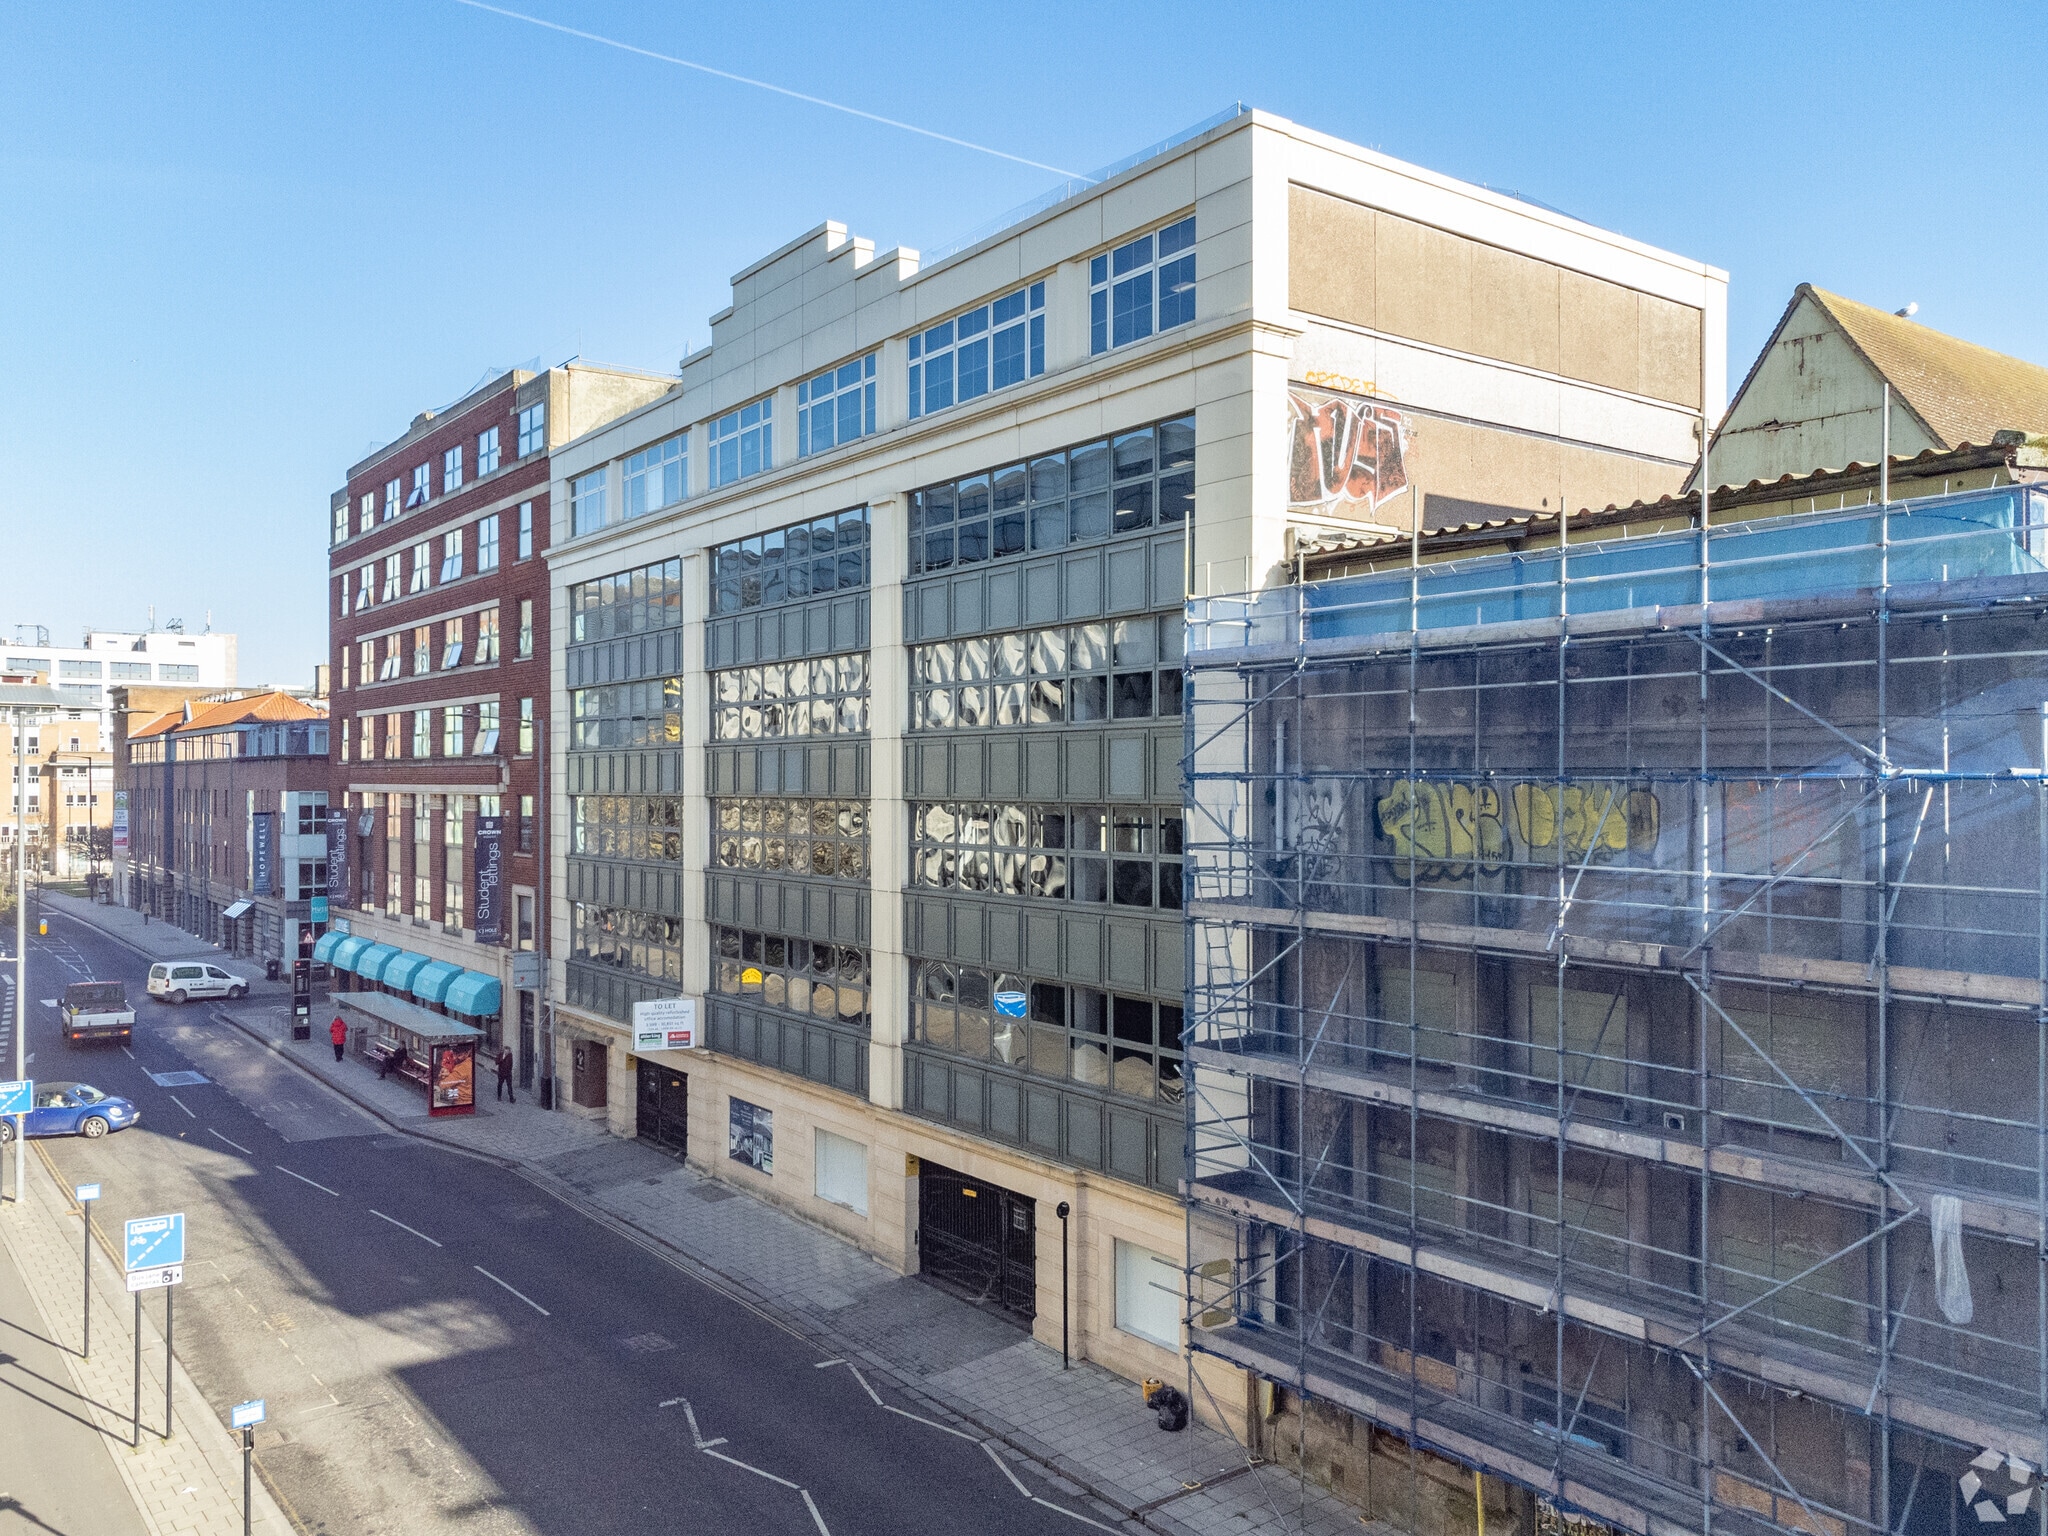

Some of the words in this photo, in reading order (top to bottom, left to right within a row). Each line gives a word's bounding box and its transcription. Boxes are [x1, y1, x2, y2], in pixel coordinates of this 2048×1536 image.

[329, 849, 339, 888] Student
[487, 842, 501, 886] lettings
[477, 869, 490, 919] Student
[664, 1002, 676, 1010] LET
